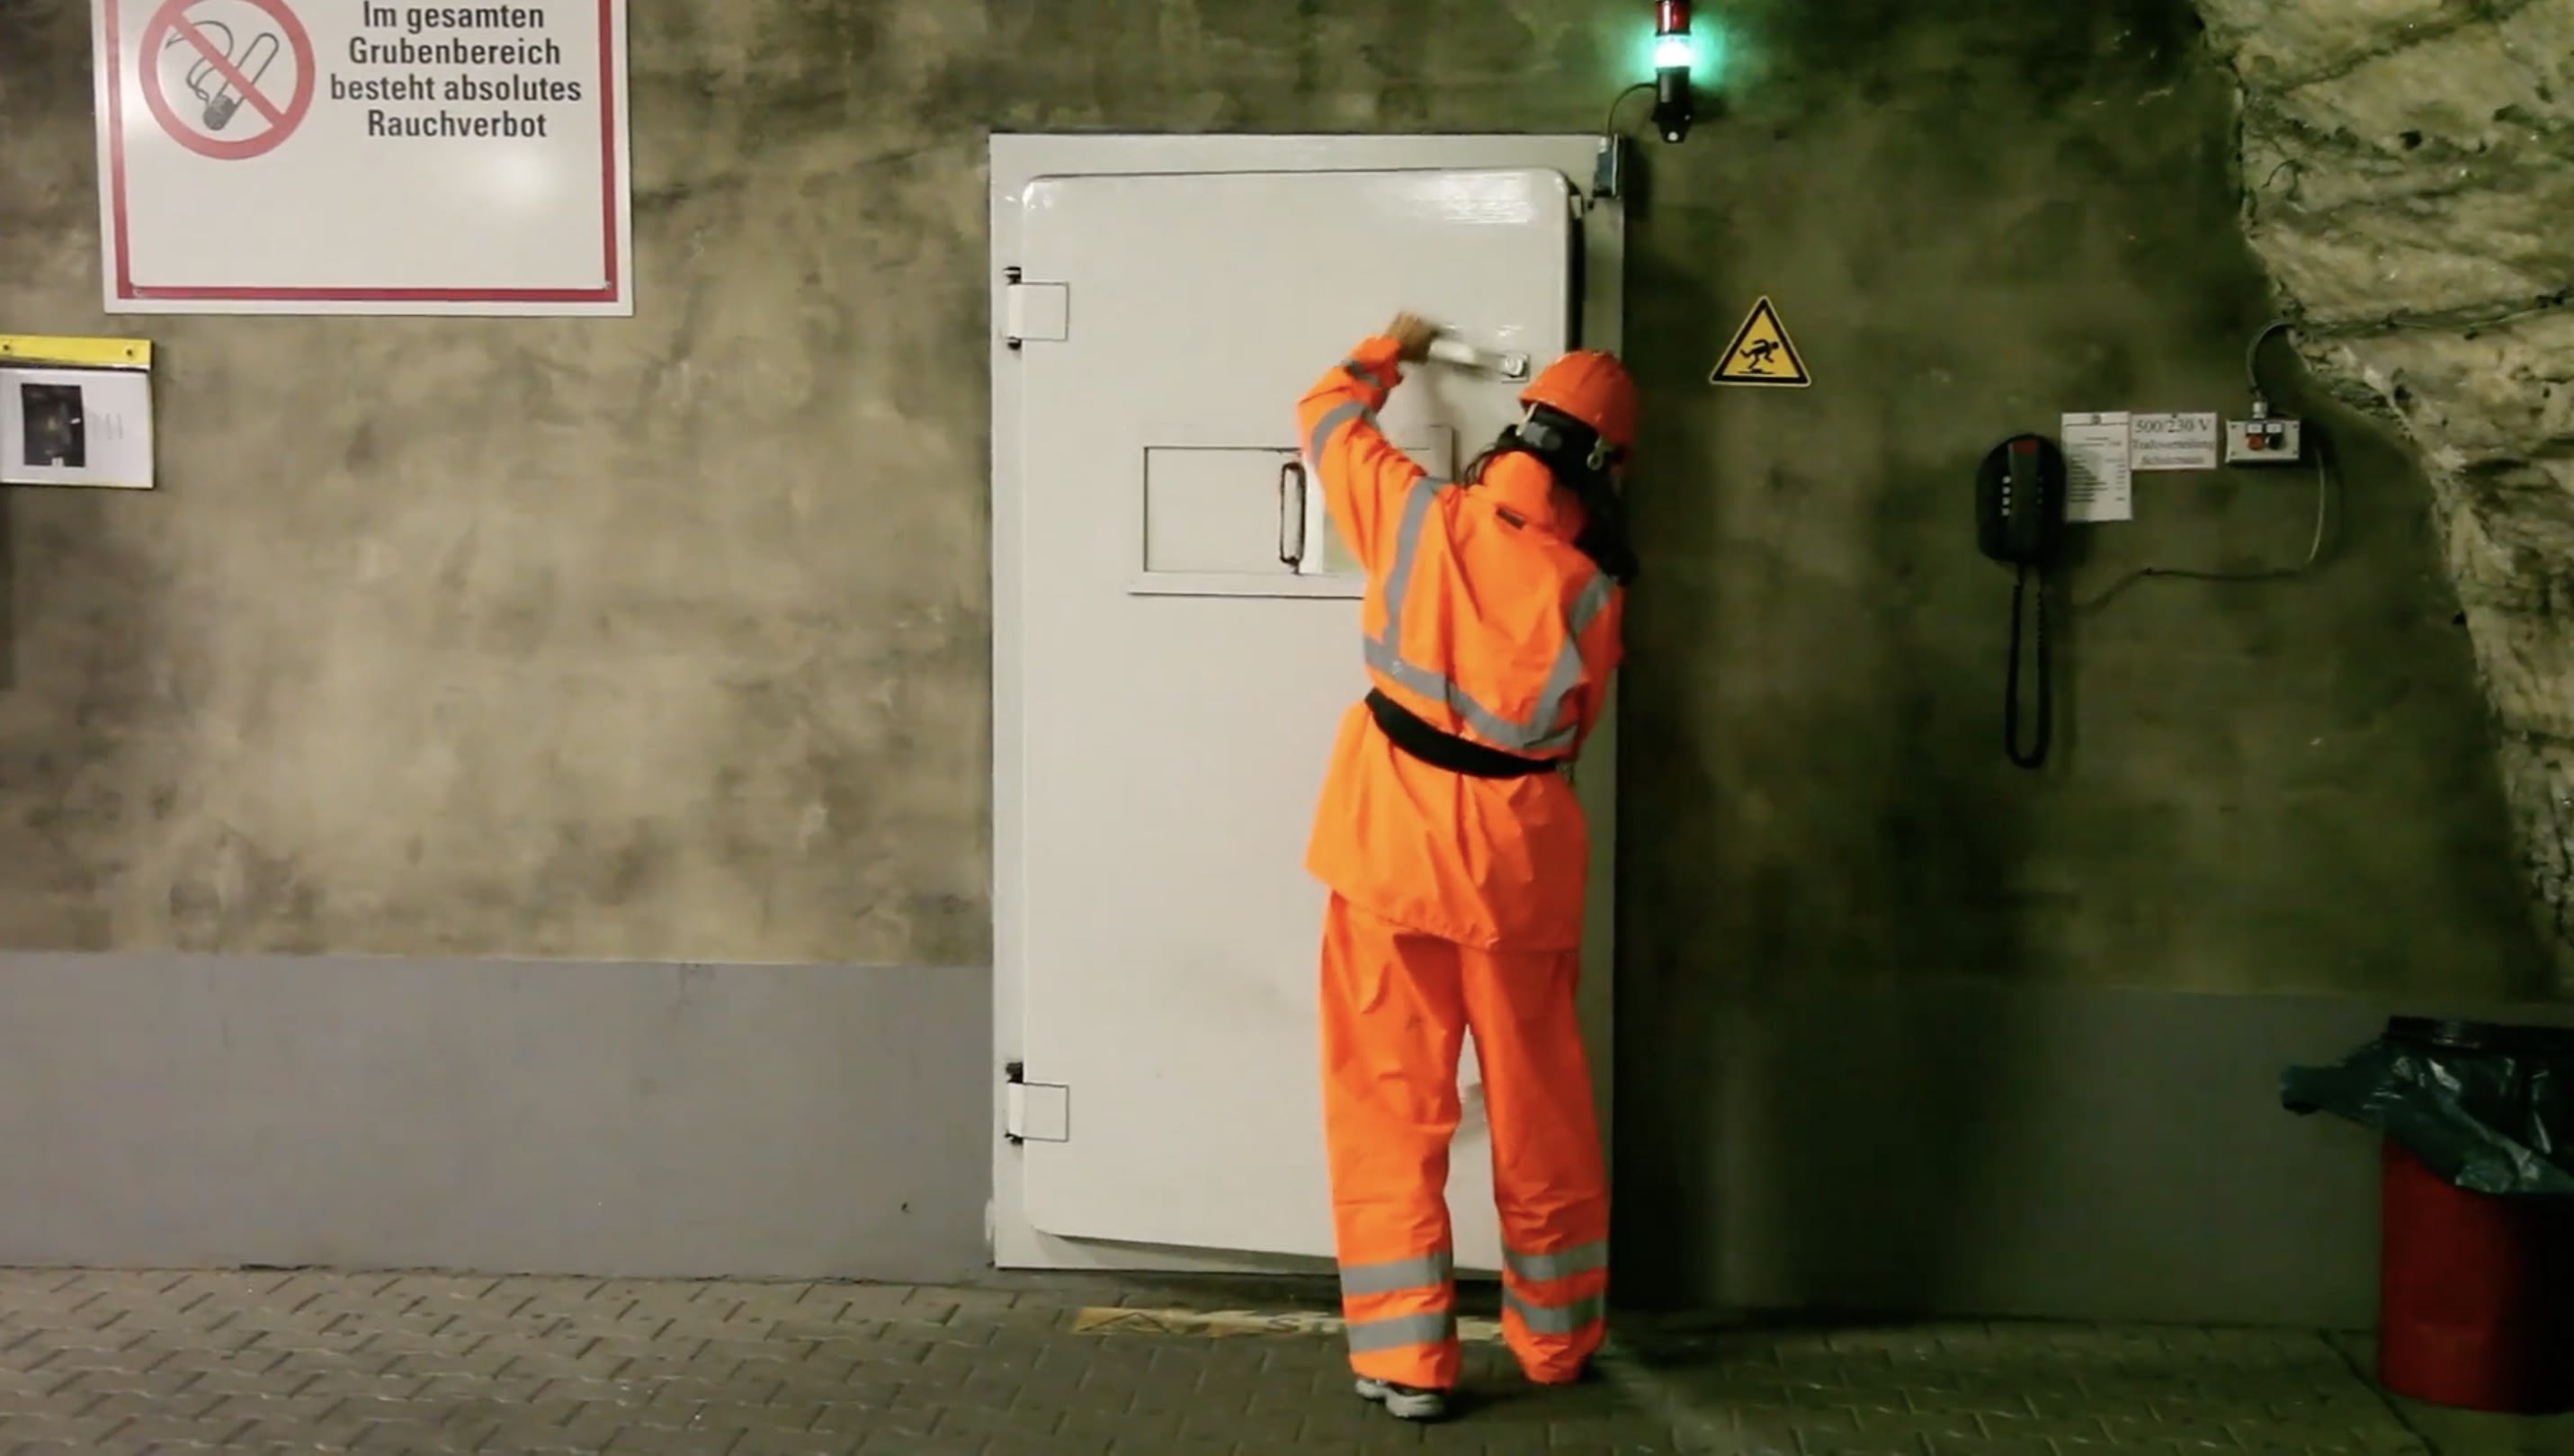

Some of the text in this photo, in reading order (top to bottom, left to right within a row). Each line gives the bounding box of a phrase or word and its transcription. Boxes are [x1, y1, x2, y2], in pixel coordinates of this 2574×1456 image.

[363, 1, 544, 34] Im gesamten
[349, 37, 560, 64] Grubenbereich
[330, 73, 582, 101] besteht absolutes
[368, 110, 547, 137] Rauchverbot
[2198, 418, 2212, 431] V
